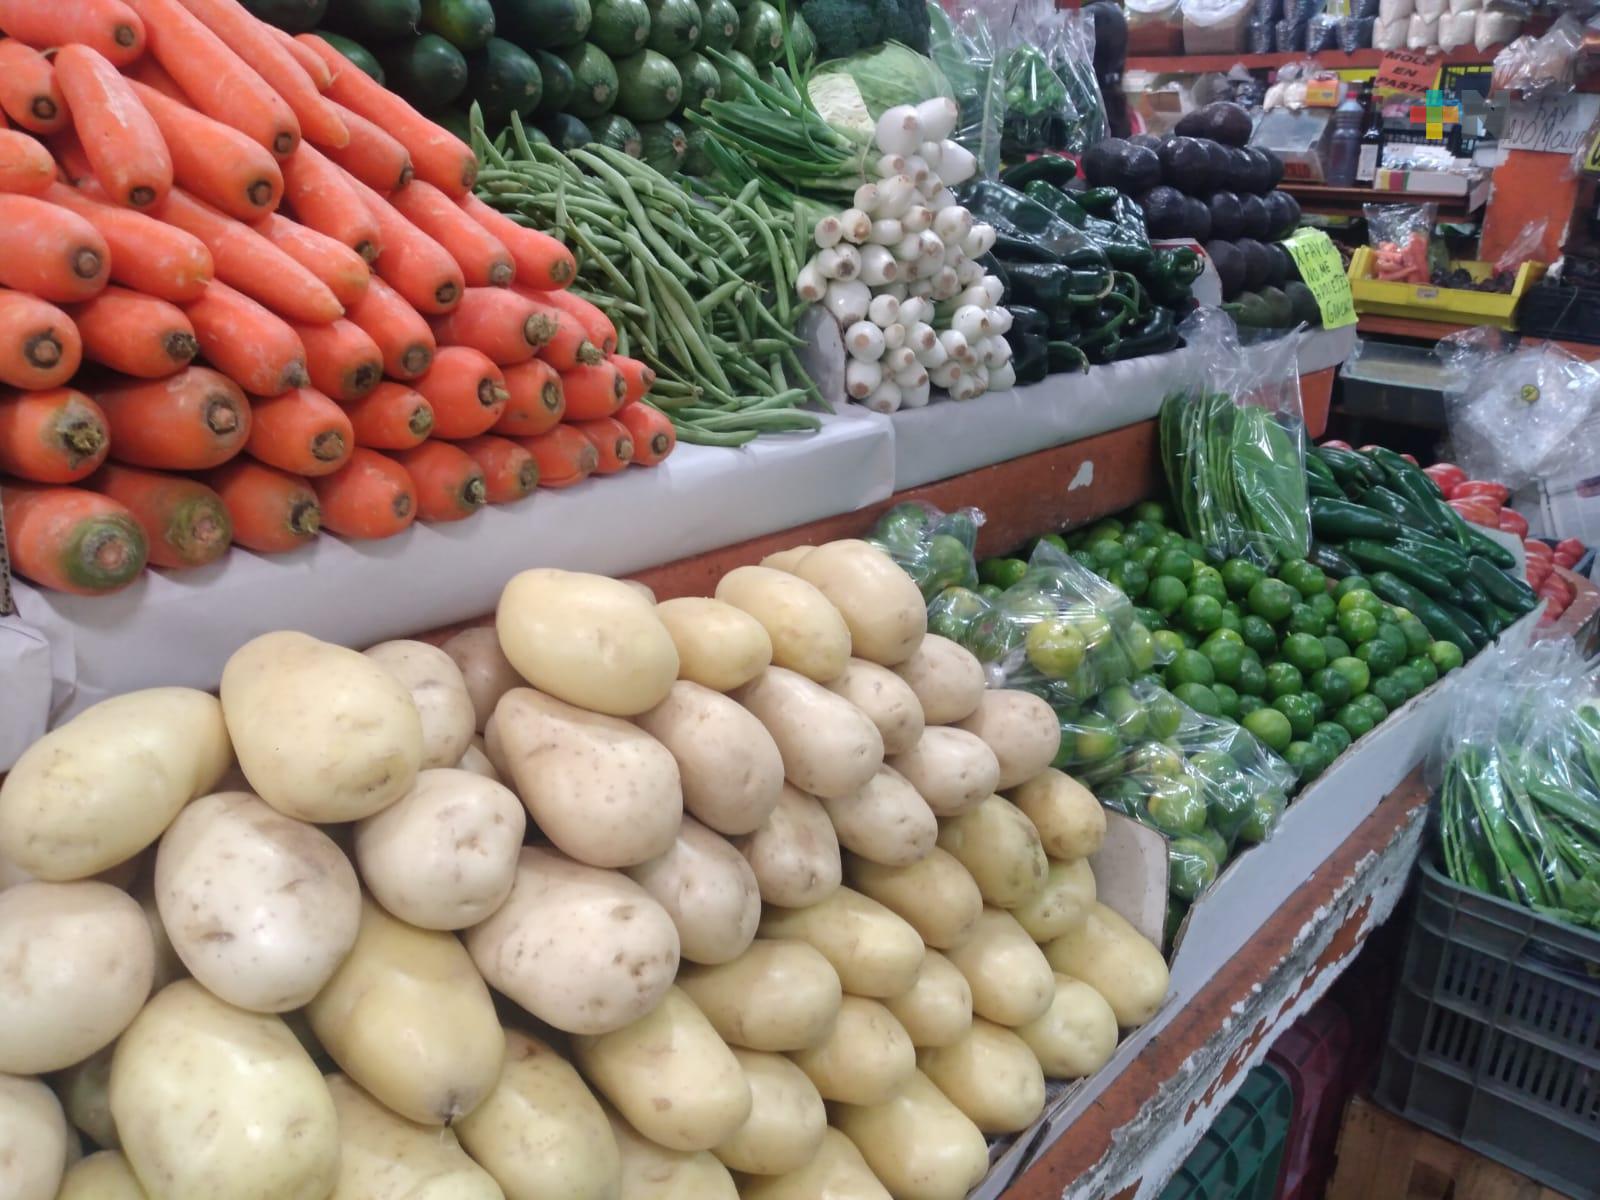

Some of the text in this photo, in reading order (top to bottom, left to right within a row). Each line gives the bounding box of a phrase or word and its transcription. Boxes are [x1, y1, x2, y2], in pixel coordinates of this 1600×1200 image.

[1385, 51, 1434, 66] MOLE
[1392, 66, 1418, 77] EN
[1376, 76, 1430, 93] PASTA
[1305, 267, 1320, 283] NO
